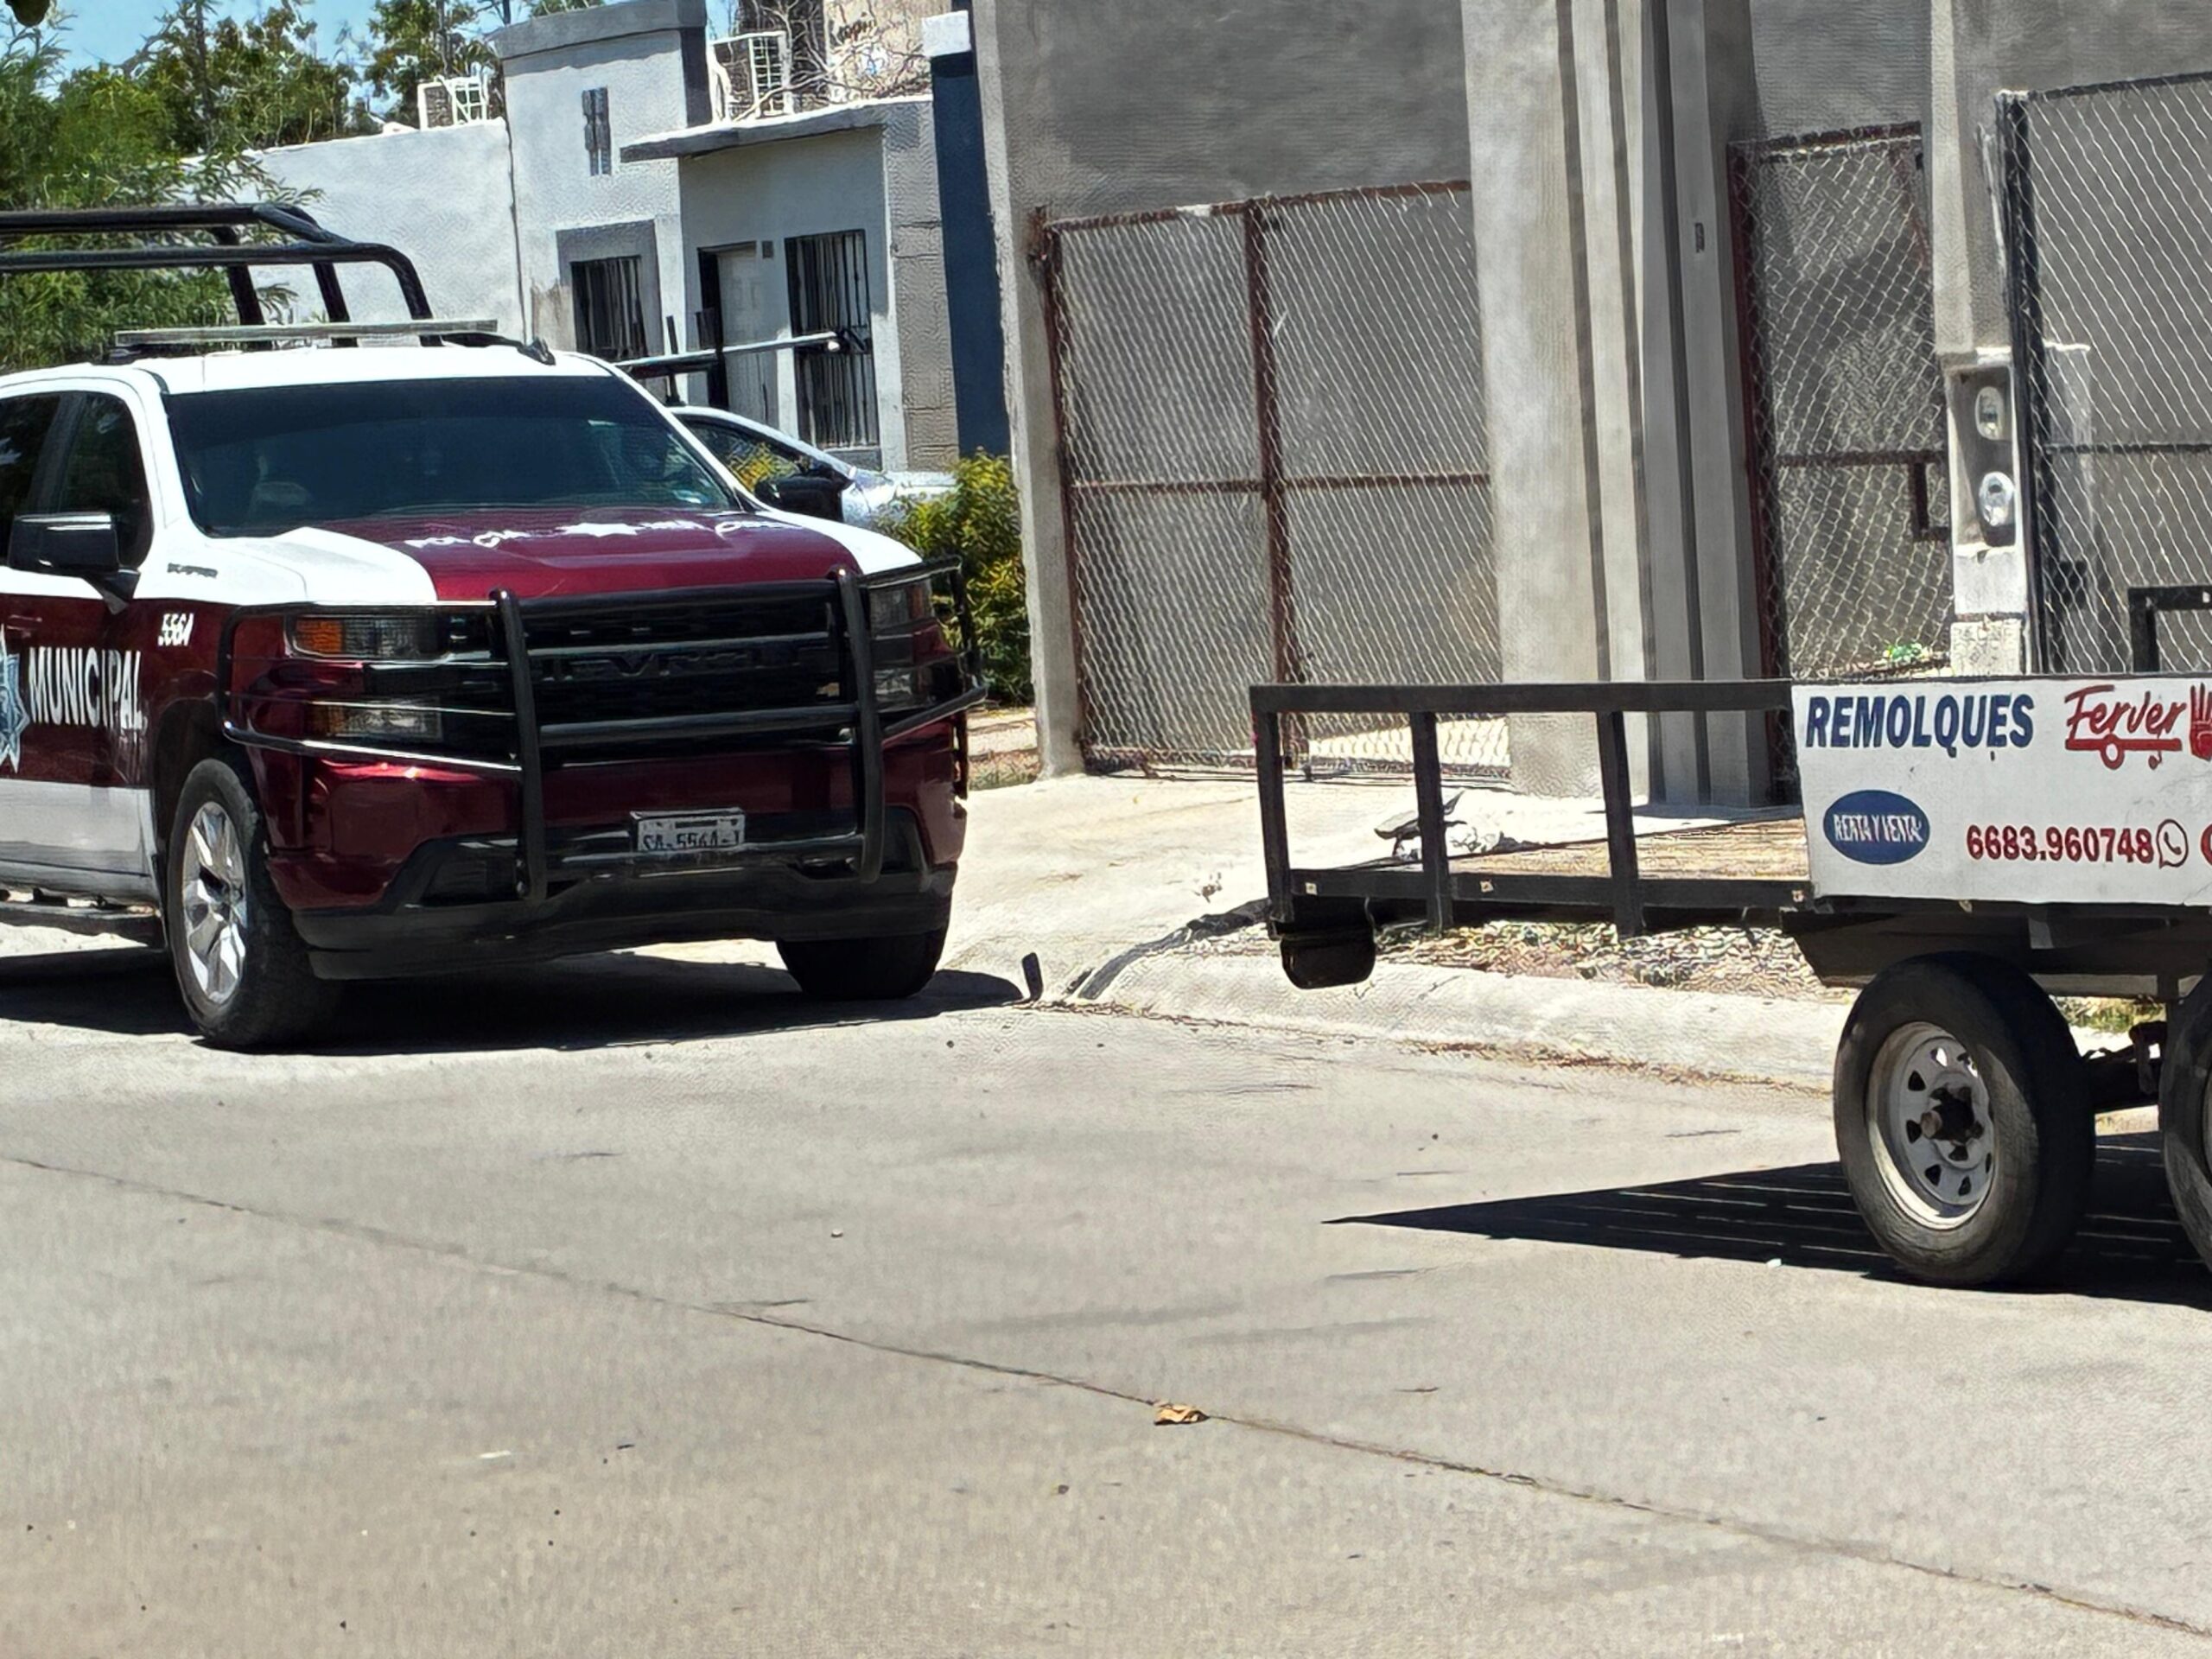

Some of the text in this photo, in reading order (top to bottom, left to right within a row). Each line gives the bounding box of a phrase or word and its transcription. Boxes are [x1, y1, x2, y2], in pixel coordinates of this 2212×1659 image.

[29, 645, 143, 730] MUNICIPAL
[1805, 693, 2035, 757] REMOLQUES
[1833, 814, 1872, 842] RENTA
[1872, 815, 1880, 842] Y
[1967, 824, 2155, 863] 6683.960748
